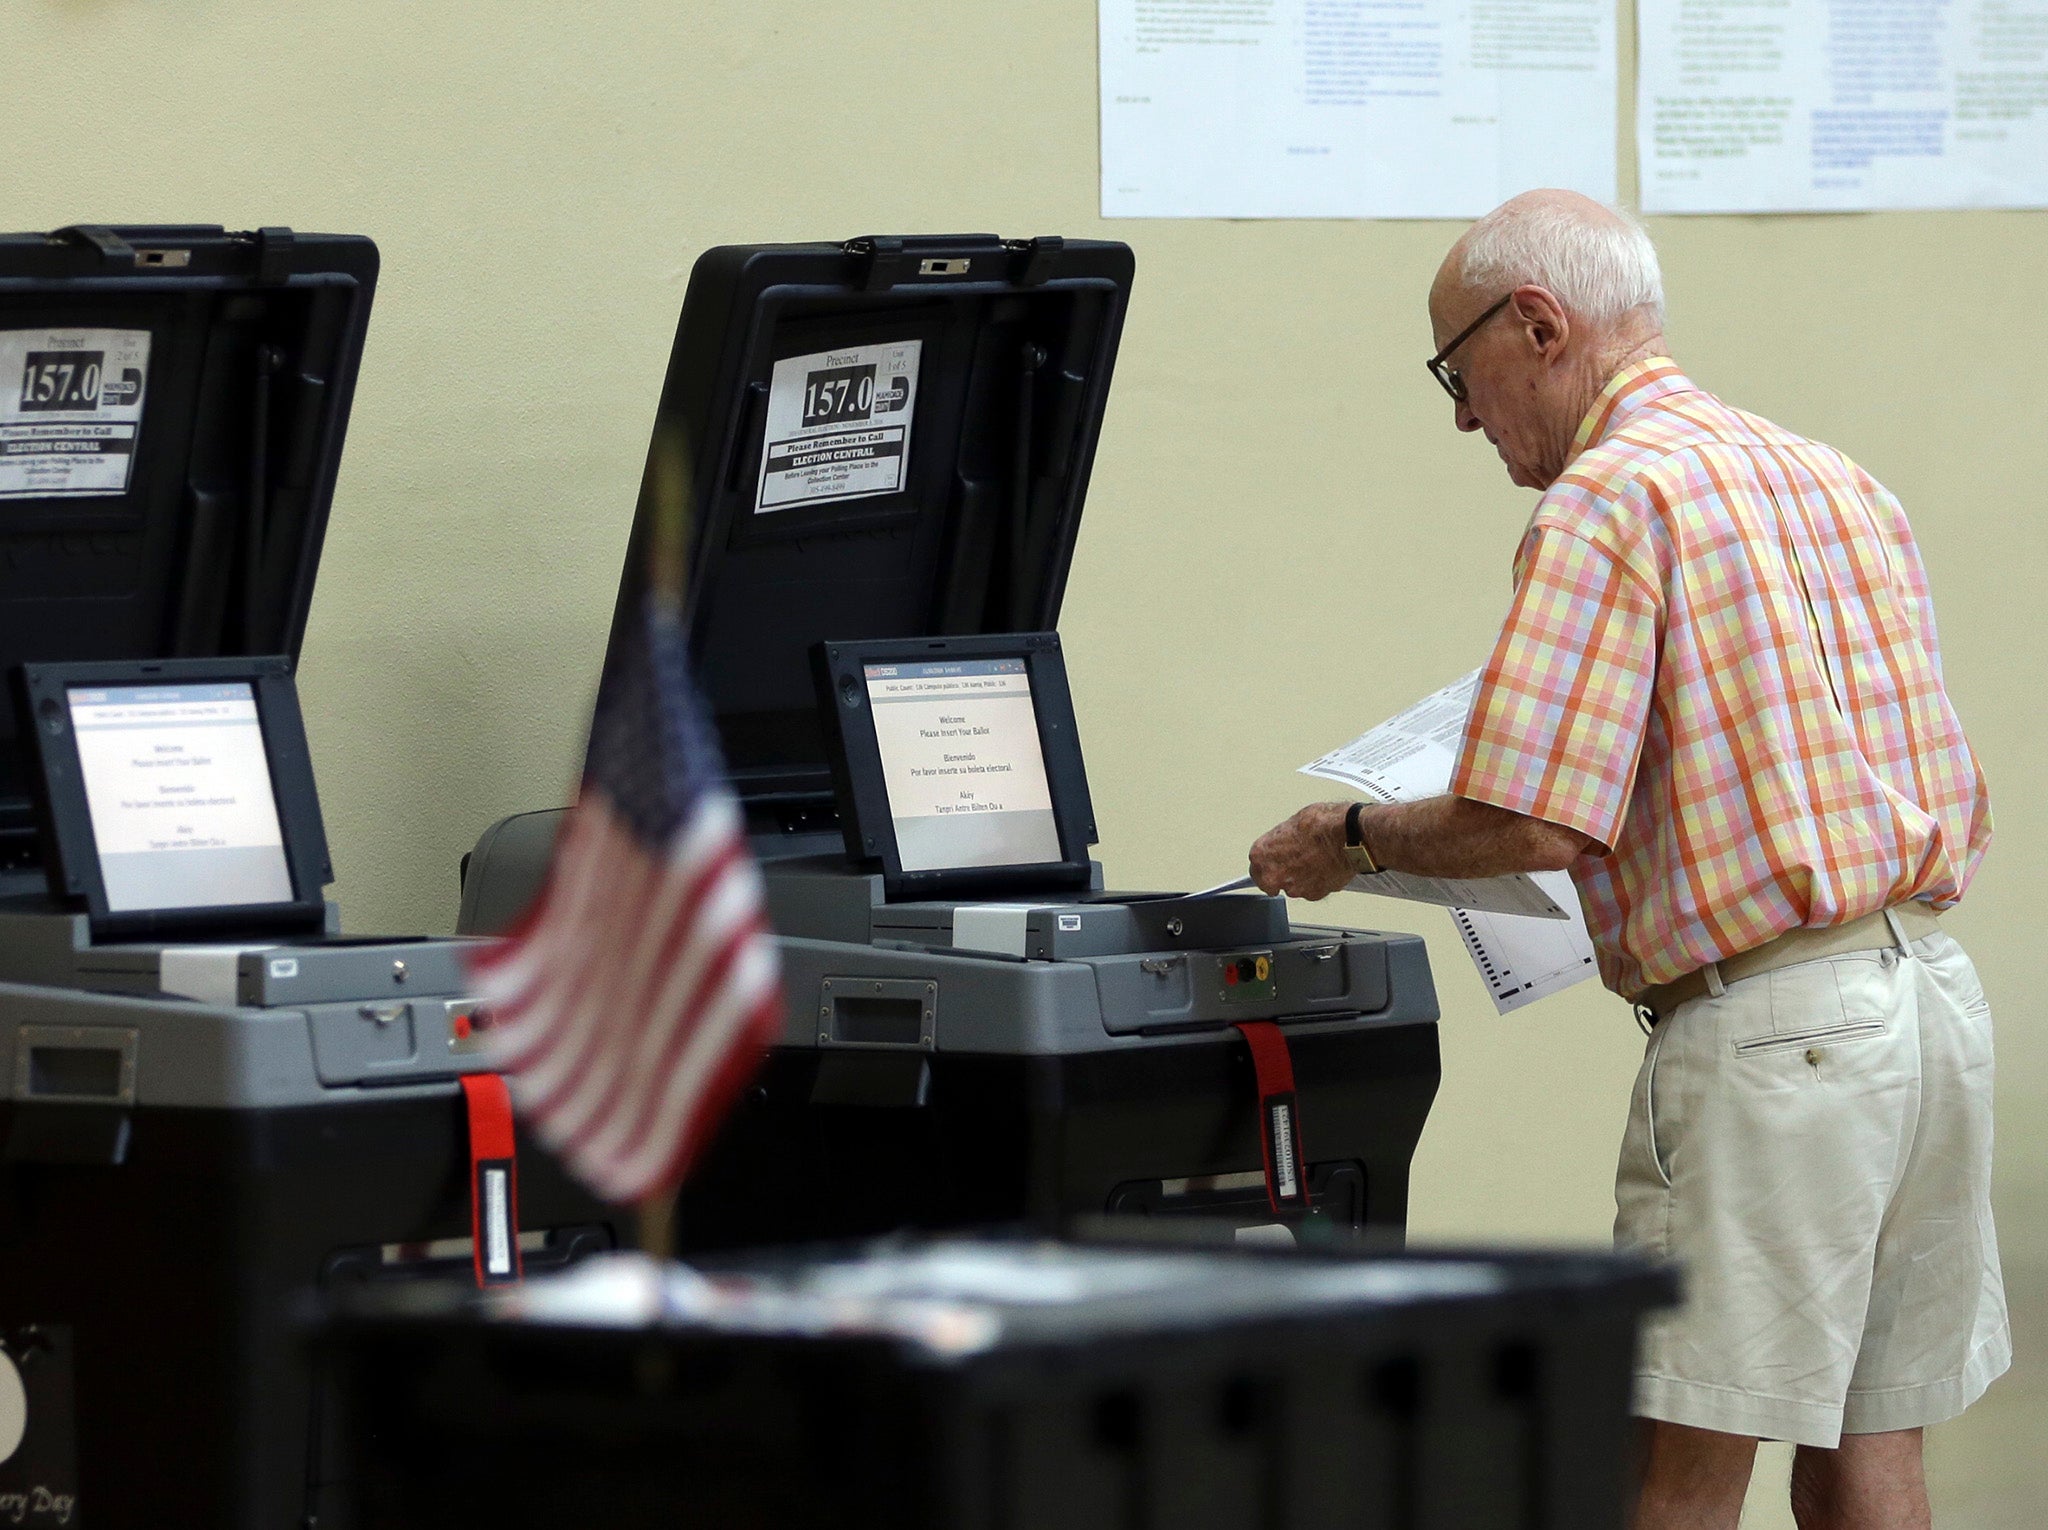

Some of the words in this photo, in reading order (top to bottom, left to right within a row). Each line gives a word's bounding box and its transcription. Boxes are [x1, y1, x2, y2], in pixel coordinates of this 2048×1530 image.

[826, 352, 859, 367] Precinct
[23, 364, 100, 402] 157.0
[805, 376, 873, 418] 157.0
[31, 427, 81, 436] Remember
[53, 441, 101, 451] CENTRAL
[787, 442, 812, 453] Please
[813, 435, 857, 449] Remember
[857, 435, 866, 443] to
[867, 433, 884, 441] Call
[792, 452, 833, 467] ELECTION
[833, 447, 875, 460] CENTRAL
[831, 464, 848, 473] Polling
[807, 474, 831, 484] Collection
[832, 473, 850, 481] Center
[939, 716, 966, 724] Welcome
[920, 729, 939, 738] Please
[941, 728, 957, 737] Insert
[958, 728, 971, 736] Your
[973, 727, 990, 735] Ballot
[943, 752, 976, 762] Bienvenido
[911, 768, 921, 776] Por
[922, 767, 937, 776] favor
[938, 766, 958, 775] inserte
[968, 765, 985, 773] boleta
[32, 1486, 76, 1525] Day
